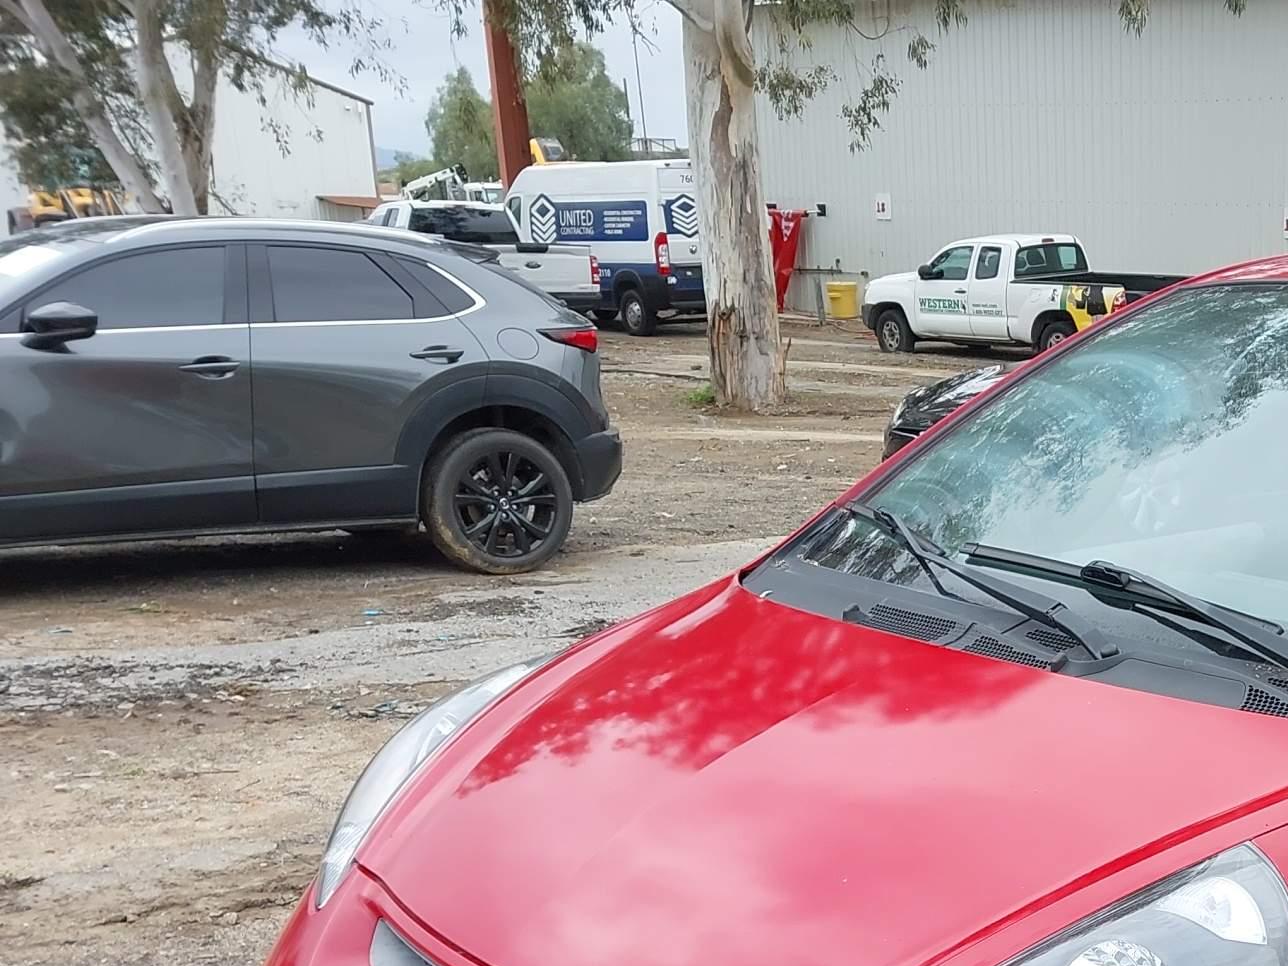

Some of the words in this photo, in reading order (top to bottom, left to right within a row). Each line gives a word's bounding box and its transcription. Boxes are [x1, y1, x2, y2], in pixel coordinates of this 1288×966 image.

[559, 209, 594, 227] UNITED
[560, 226, 594, 236] CONTRACTING
[919, 297, 960, 310] WESTERN
